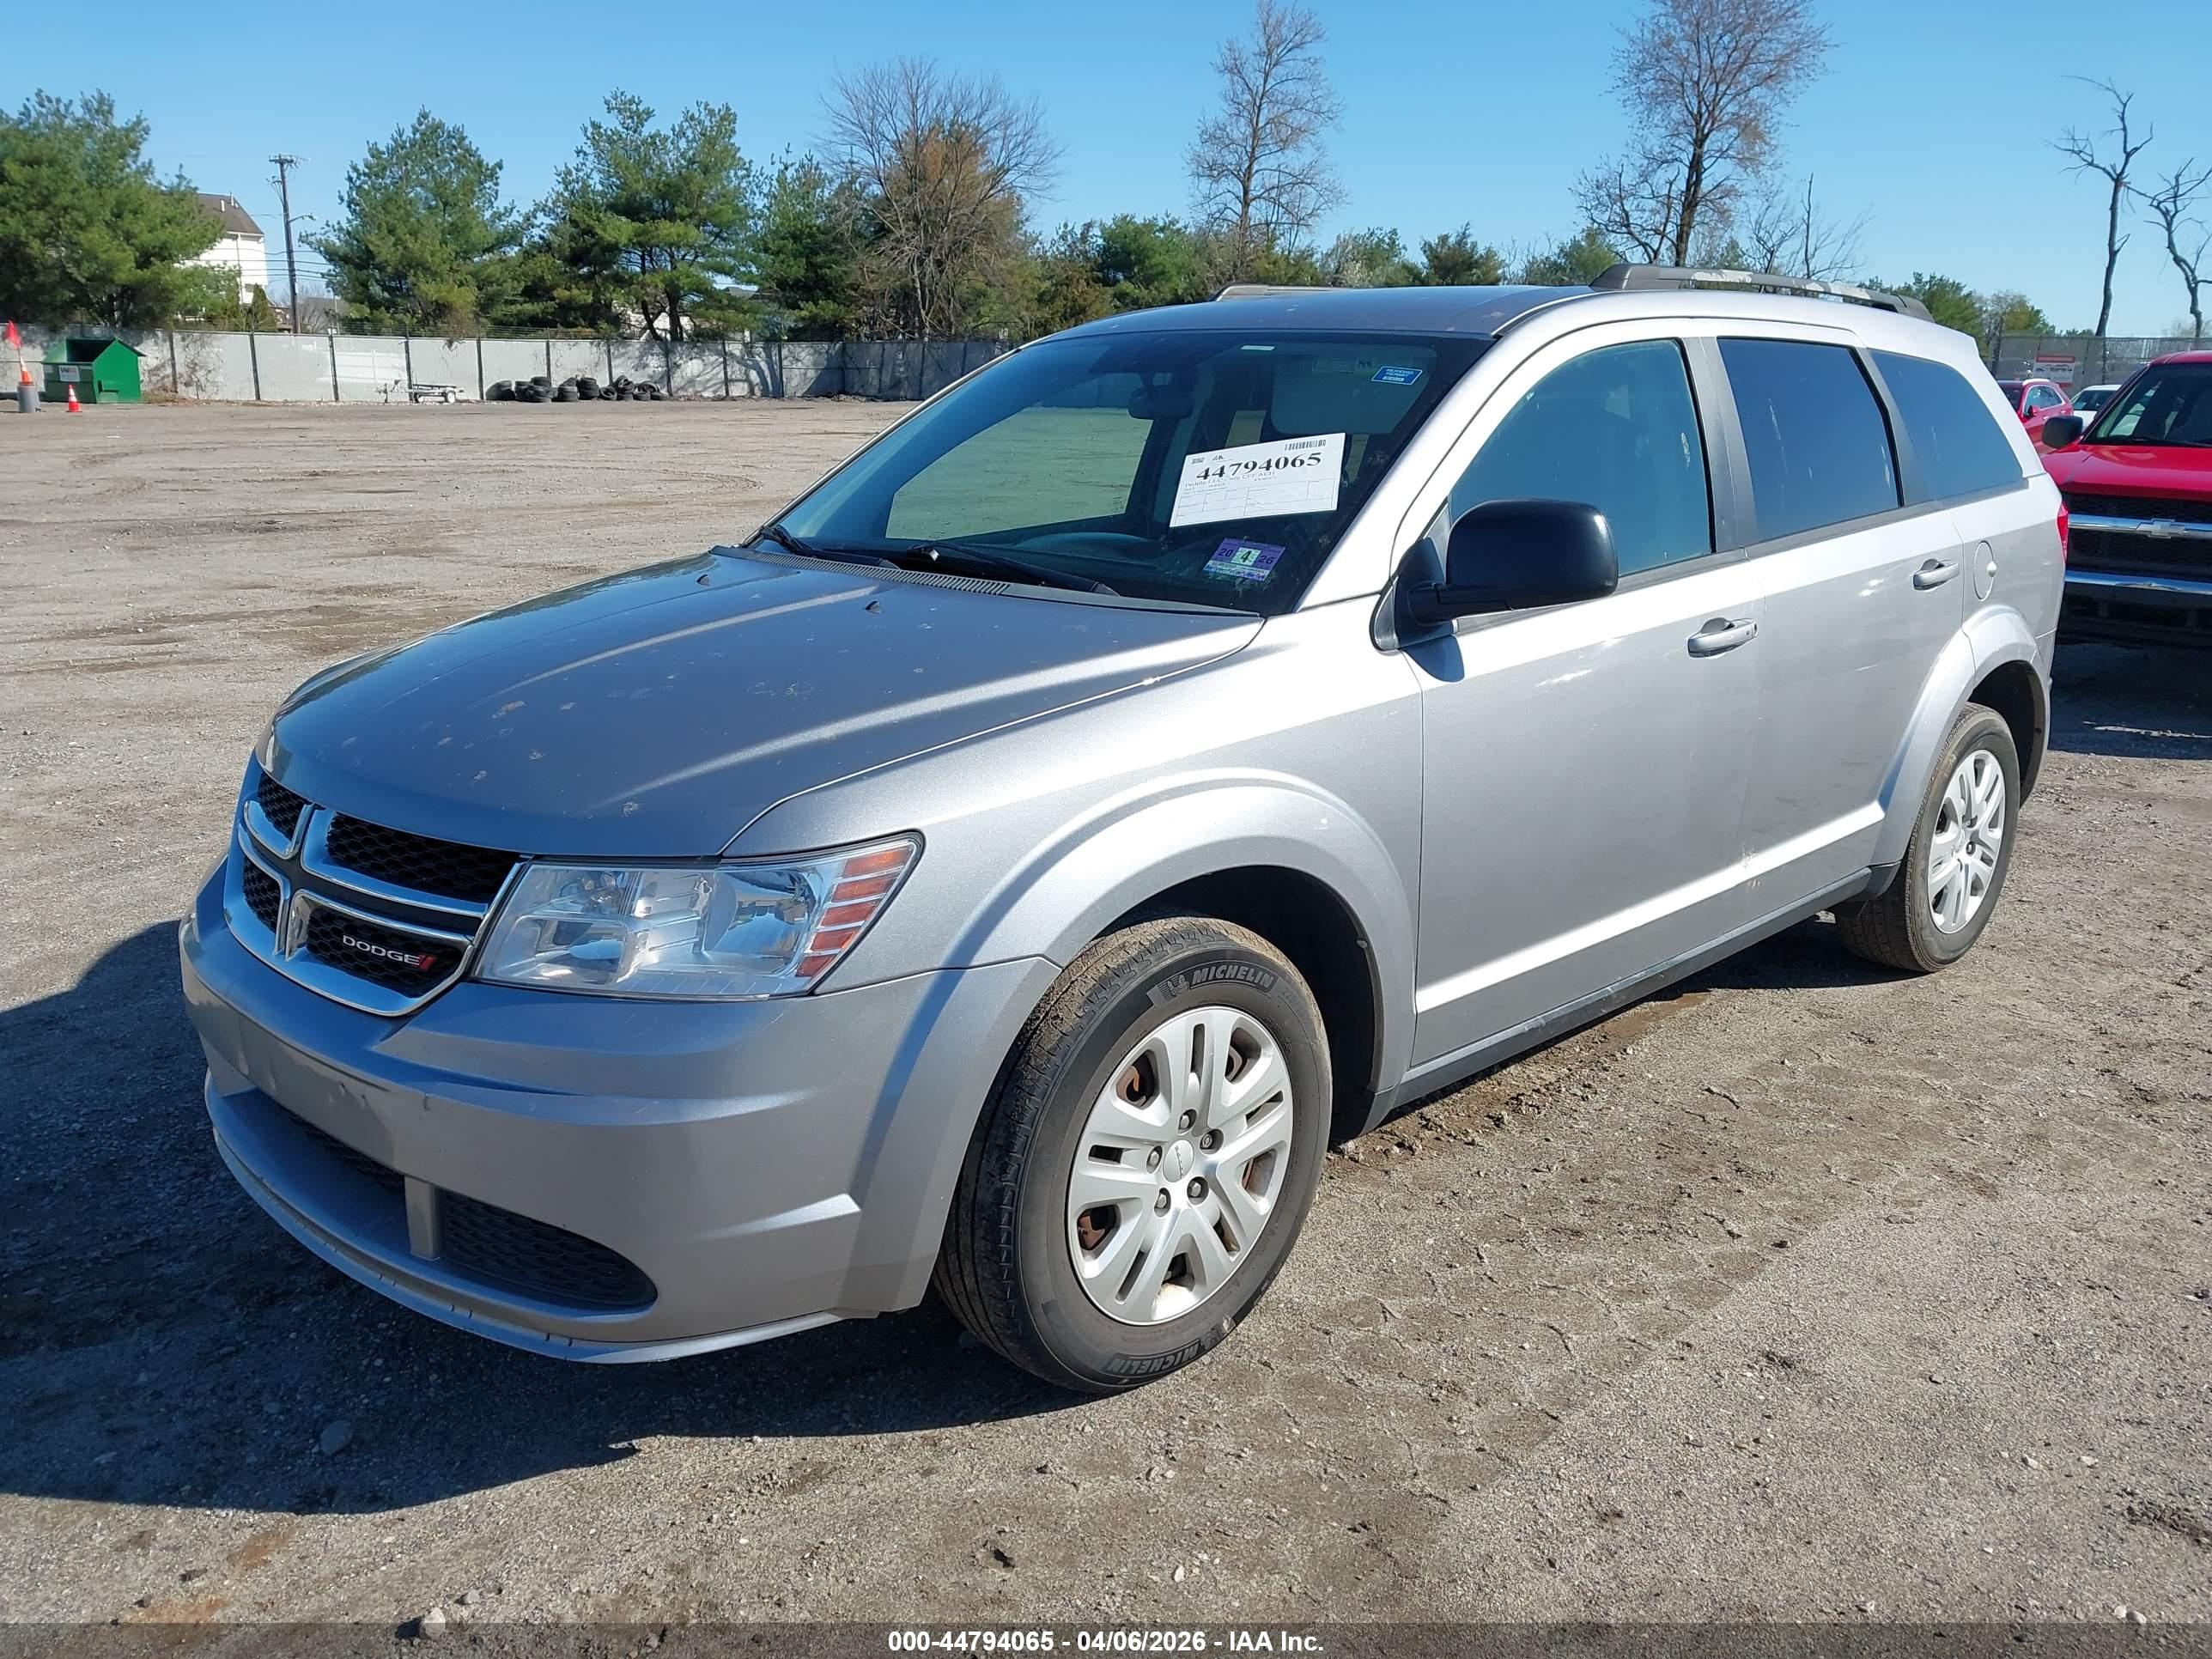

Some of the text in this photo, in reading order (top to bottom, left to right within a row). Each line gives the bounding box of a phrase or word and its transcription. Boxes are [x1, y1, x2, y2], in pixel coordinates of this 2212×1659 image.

[1196, 452, 1322, 480] 44794065
[1219, 548, 1275, 564] 20 4 26
[343, 934, 421, 966] DODGE
[1192, 964, 1274, 988] MICHELIN
[1106, 1343, 1200, 1374] MICHELIN
